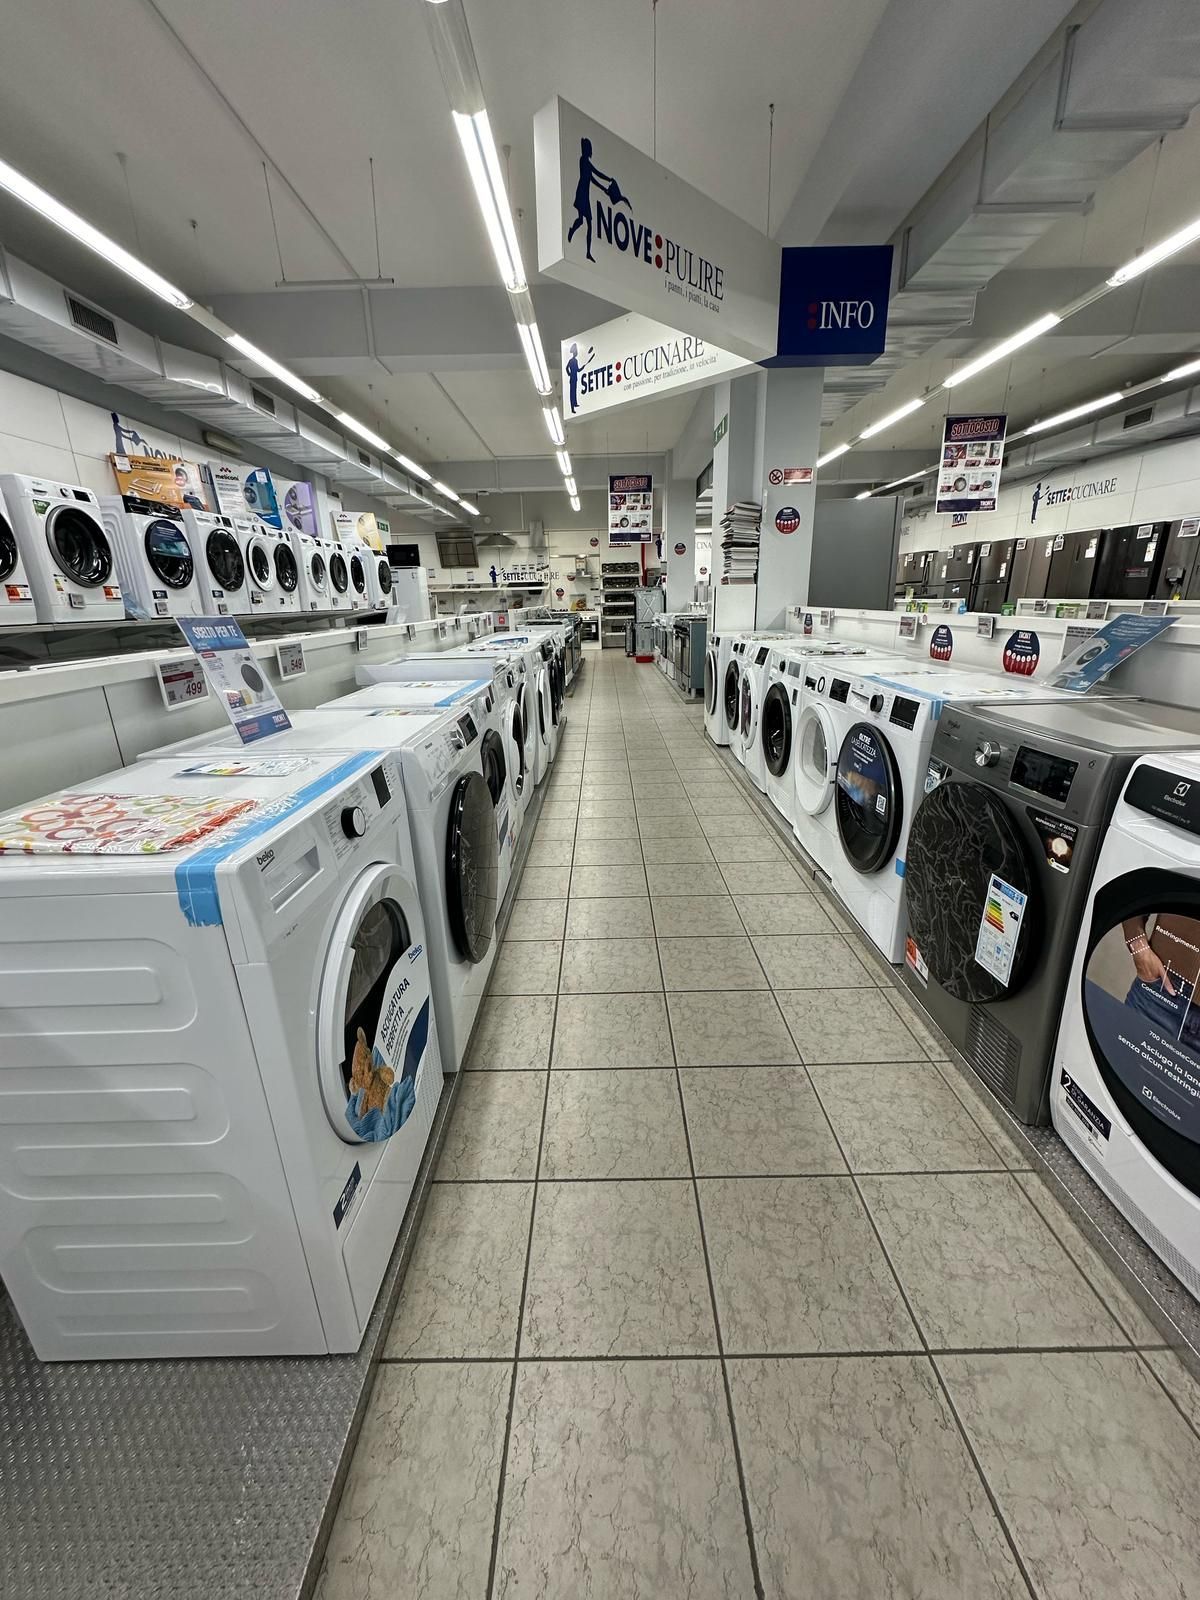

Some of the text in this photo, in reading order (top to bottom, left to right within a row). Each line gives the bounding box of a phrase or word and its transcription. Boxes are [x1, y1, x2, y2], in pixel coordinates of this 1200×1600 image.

[709, 301, 720, 313] casa
[951, 419, 1000, 437] SOTTOCOSTO
[215, 473, 240, 481] meliconi
[186, 681, 202, 696] 499
[257, 849, 275, 866] beko
[1155, 925, 1200, 953] Restringimento
[408, 944, 423, 960] beko
[1141, 982, 1179, 1010] Concorrenza
[380, 977, 411, 1043] ASCIUGATURA
[385, 1005, 405, 1056] PERFETTA
[1149, 1030, 1161, 1041] 700
[1117, 1034, 1141, 1054] senza
[1141, 1051, 1163, 1071] alcun
[1140, 1040, 1174, 1067] Asciuga
[1174, 1063, 1183, 1075] la
[1063, 1074, 1072, 1093] 2
[1077, 1096, 1105, 1130] GARANZIA
[1152, 1095, 1182, 1121] Electrolux
